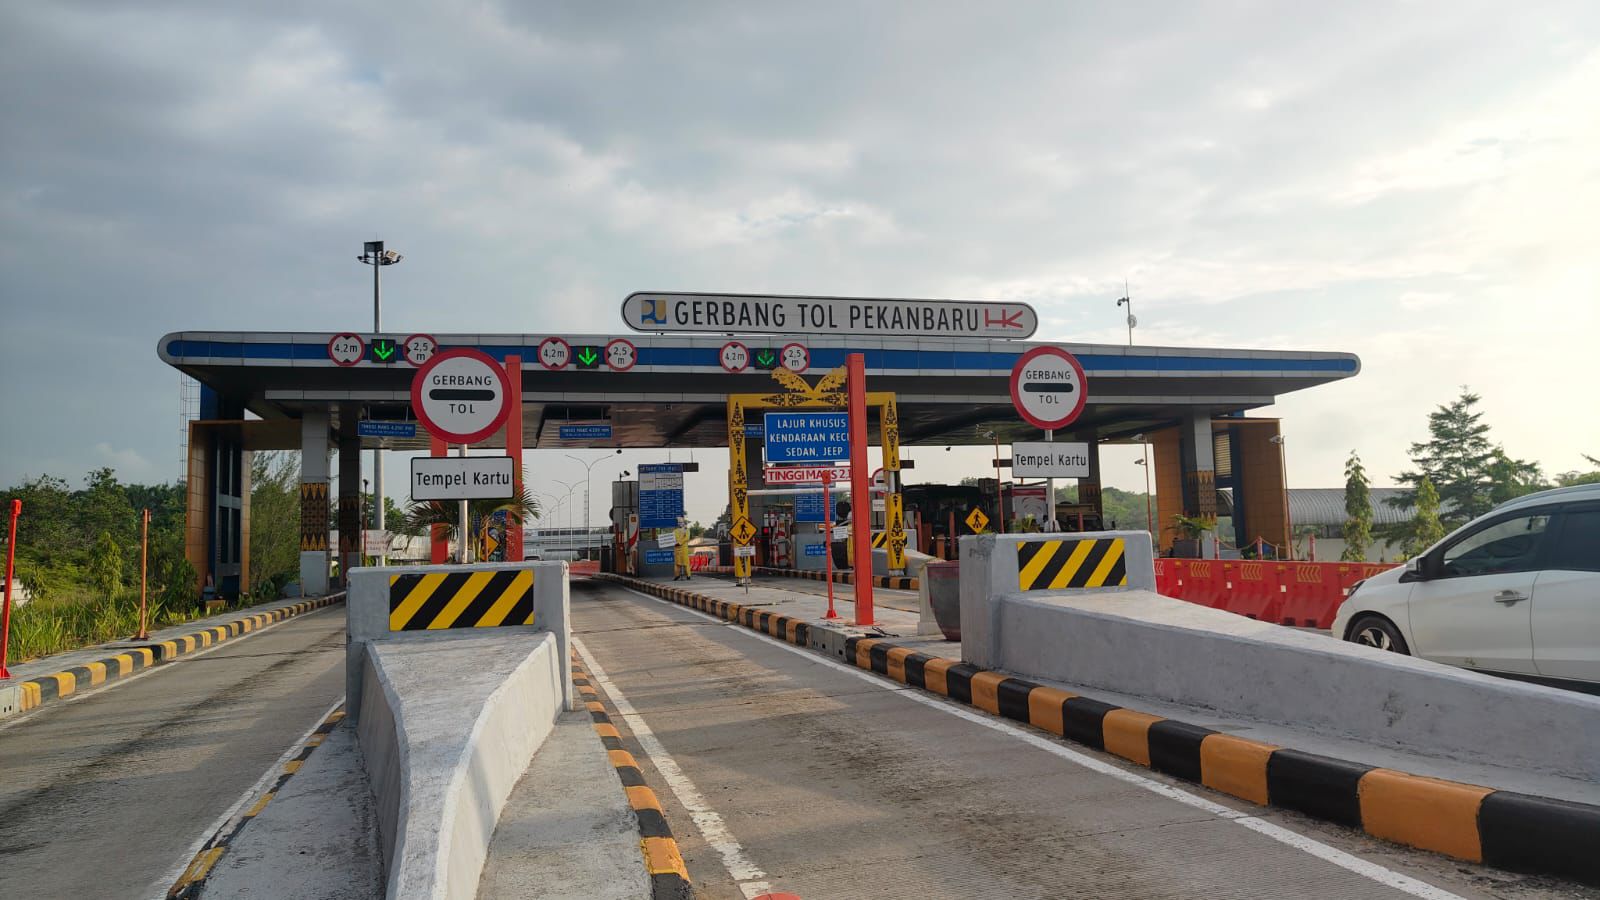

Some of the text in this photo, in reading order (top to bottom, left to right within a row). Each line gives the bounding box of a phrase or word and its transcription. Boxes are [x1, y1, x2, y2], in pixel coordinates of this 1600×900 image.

[674, 301, 786, 327] GERBANG
[797, 303, 838, 329] TOL
[850, 305, 978, 331] PEKANBARU
[432, 375, 493, 387] GERBANG
[1025, 370, 1072, 381] GERBANG
[1039, 394, 1059, 405] TOL
[449, 403, 475, 414] TOL
[777, 419, 846, 429] LAJUR KHUSUS
[769, 433, 826, 443] KENDARAAN
[785, 447, 843, 457] SEDAN, JEEP
[1015, 453, 1087, 469] Tempel Kartu
[416, 472, 510, 488] Tempel Kartu
[768, 471, 805, 481] TINGGI
[806, 469, 838, 480] MAS
